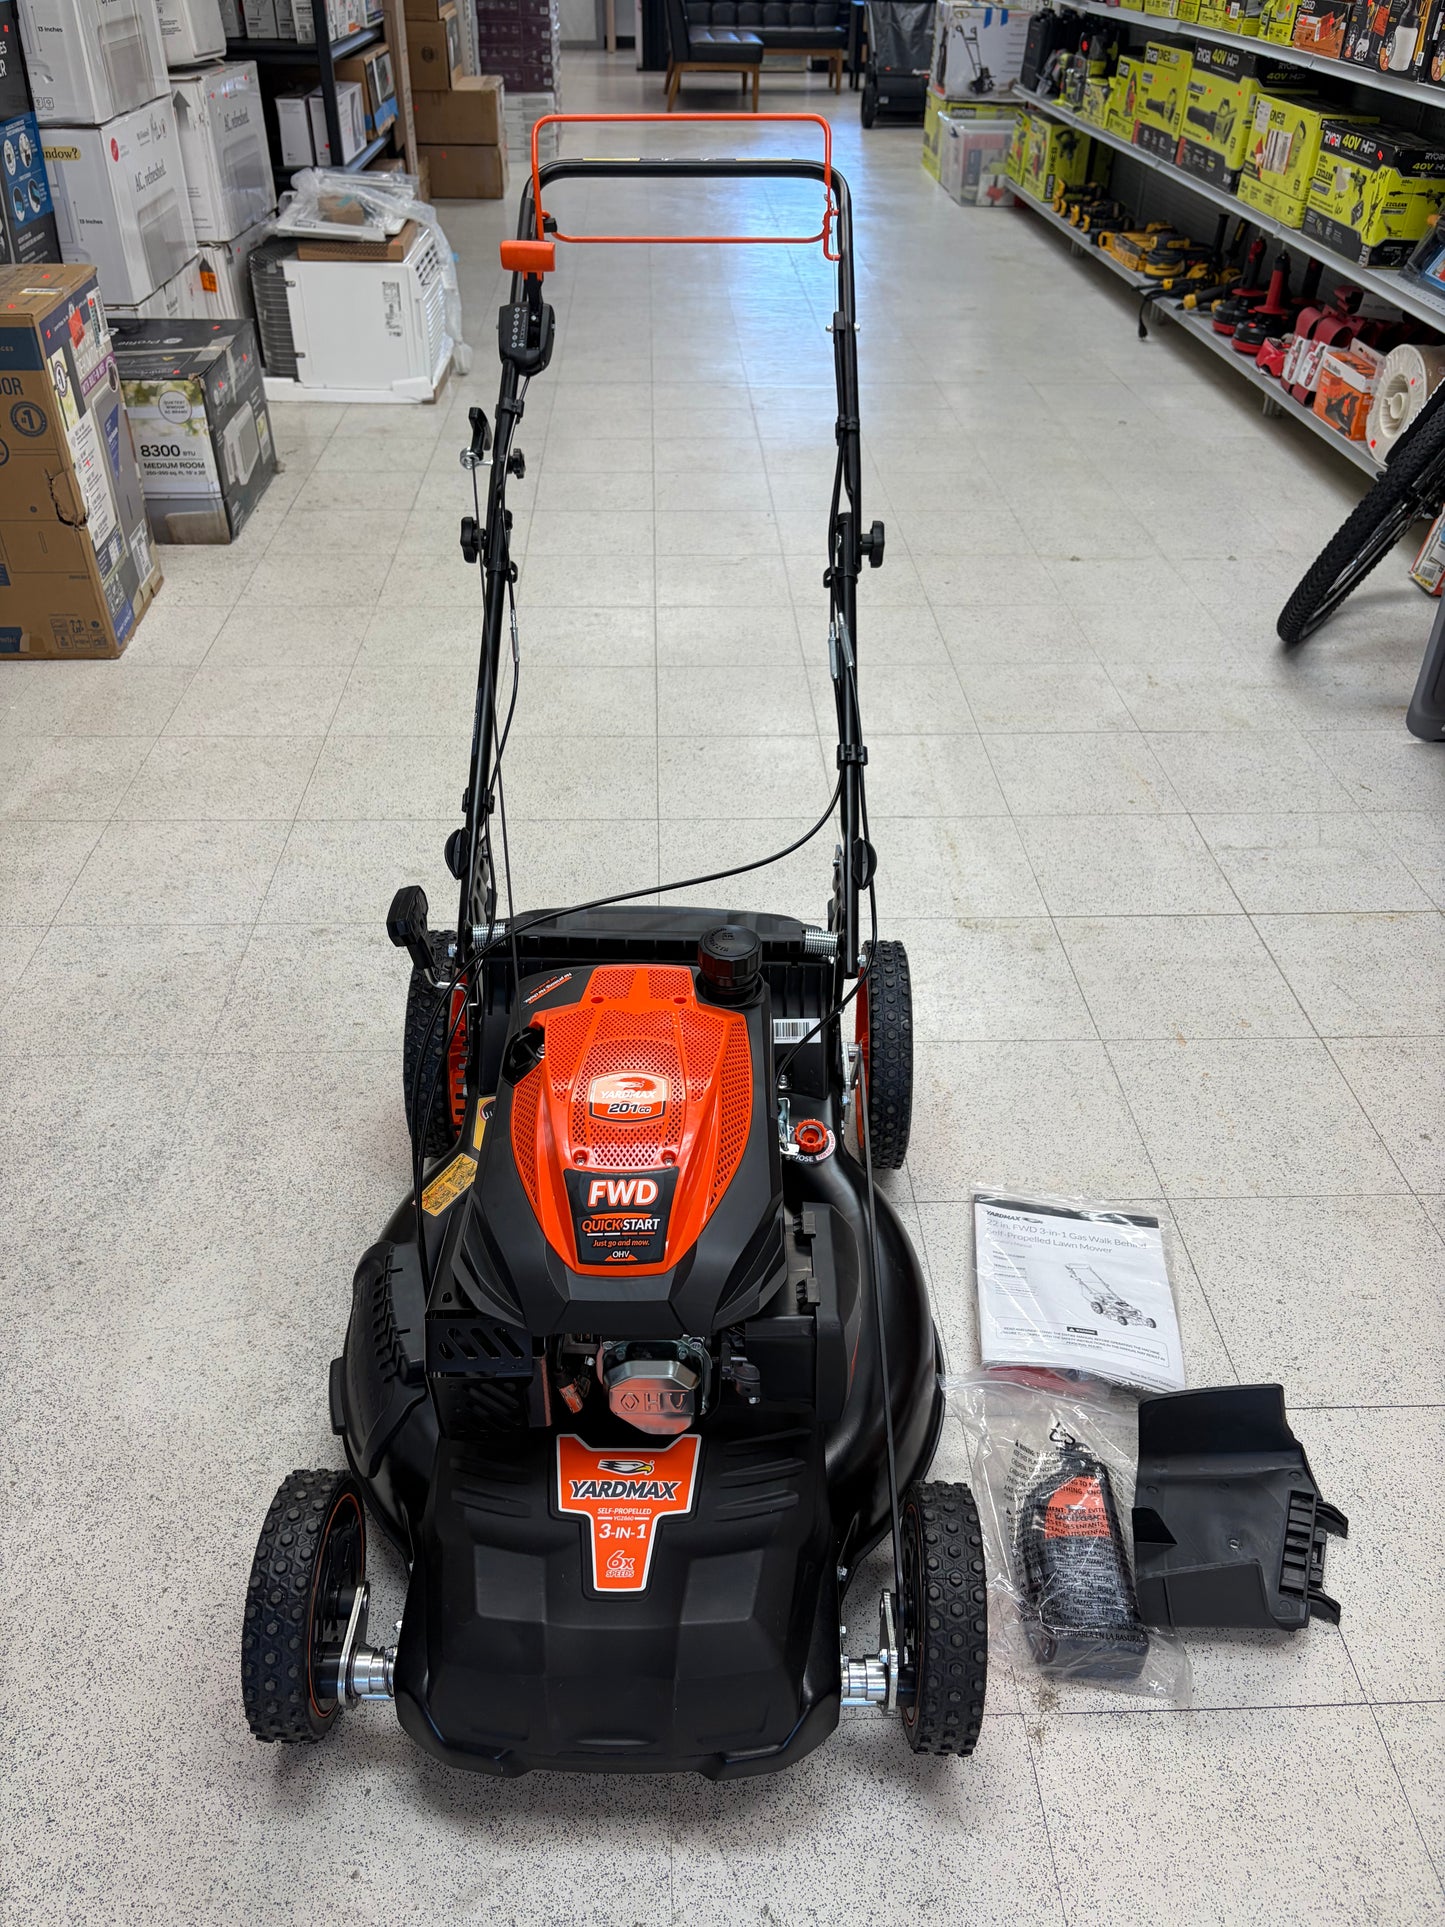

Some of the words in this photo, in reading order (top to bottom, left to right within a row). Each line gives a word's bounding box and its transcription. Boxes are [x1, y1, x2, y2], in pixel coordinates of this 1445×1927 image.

[1212, 48, 1226, 66] 40V
[1342, 133, 1361, 150] 40V
[1412, 163, 1434, 171] 40V
[0, 378, 24, 396] OR
[140, 445, 180, 457] 8300
[601, 1090, 657, 1100] YARDMAX
[588, 1179, 658, 1207] FWD
[986, 1210, 1021, 1222] YARDMAX
[1012, 1224, 1038, 1234] FWD
[1039, 1228, 1067, 1239] 3-in-1
[1069, 1232, 1088, 1242] Gas
[1089, 1235, 1112, 1245] Walk
[612, 1250, 630, 1258] OHV
[1052, 1239, 1079, 1249] Lawn
[1079, 1243, 1113, 1254] Mower
[620, 1392, 686, 1412] OHV
[570, 1480, 682, 1501] YARDMAX
[599, 1523, 647, 1539] 3-IN-1
[607, 1550, 635, 1569] 6x
[606, 1569, 634, 1578] SPEEDS
